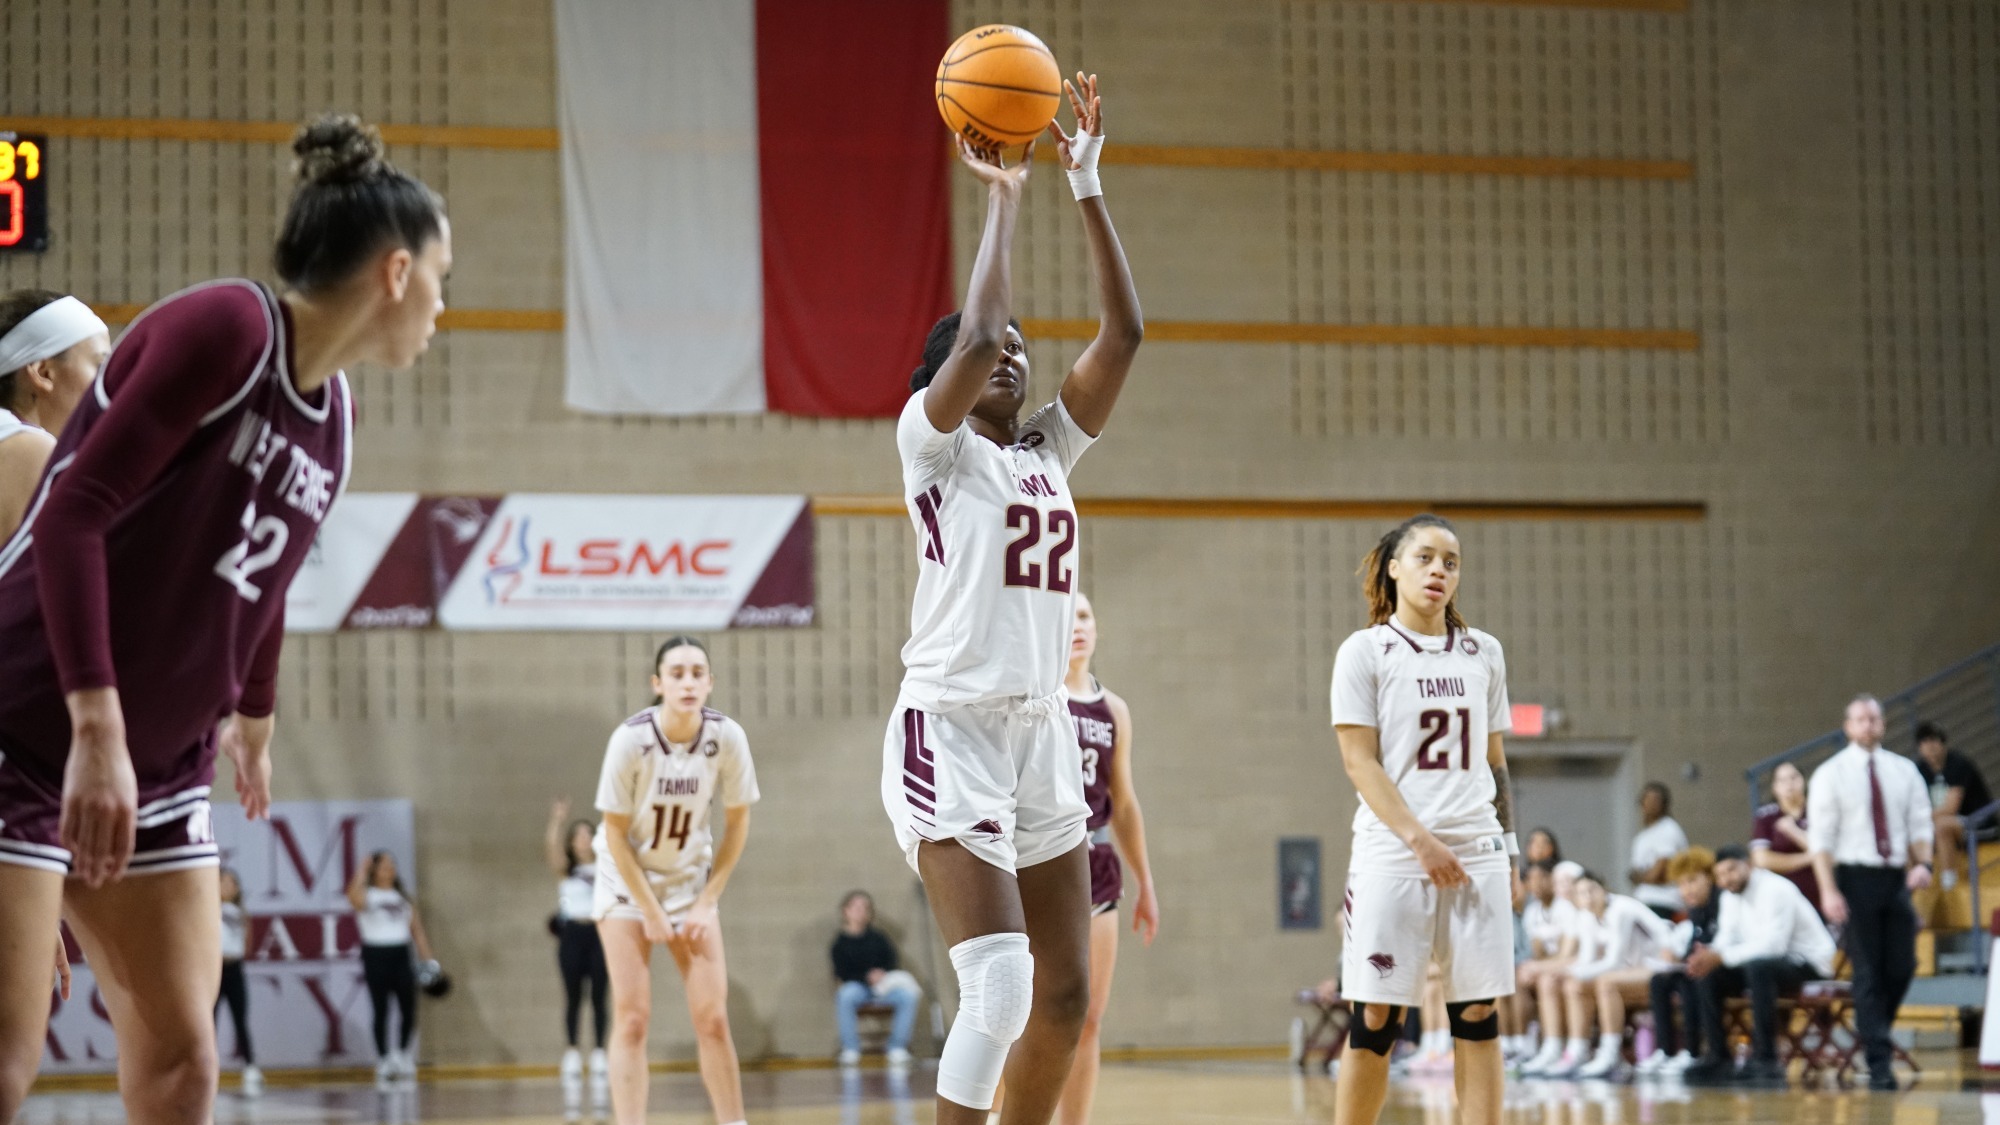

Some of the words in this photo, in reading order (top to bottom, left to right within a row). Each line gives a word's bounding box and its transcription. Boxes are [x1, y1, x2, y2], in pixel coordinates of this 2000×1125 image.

[539, 538, 732, 577] LSMC
[1003, 503, 1076, 595] 22
[1417, 676, 1466, 699] TAMIU
[1417, 706, 1471, 771] 21
[658, 777, 700, 796] TAMIU
[1079, 747, 1099, 787] 3
[651, 804, 693, 850] 14
